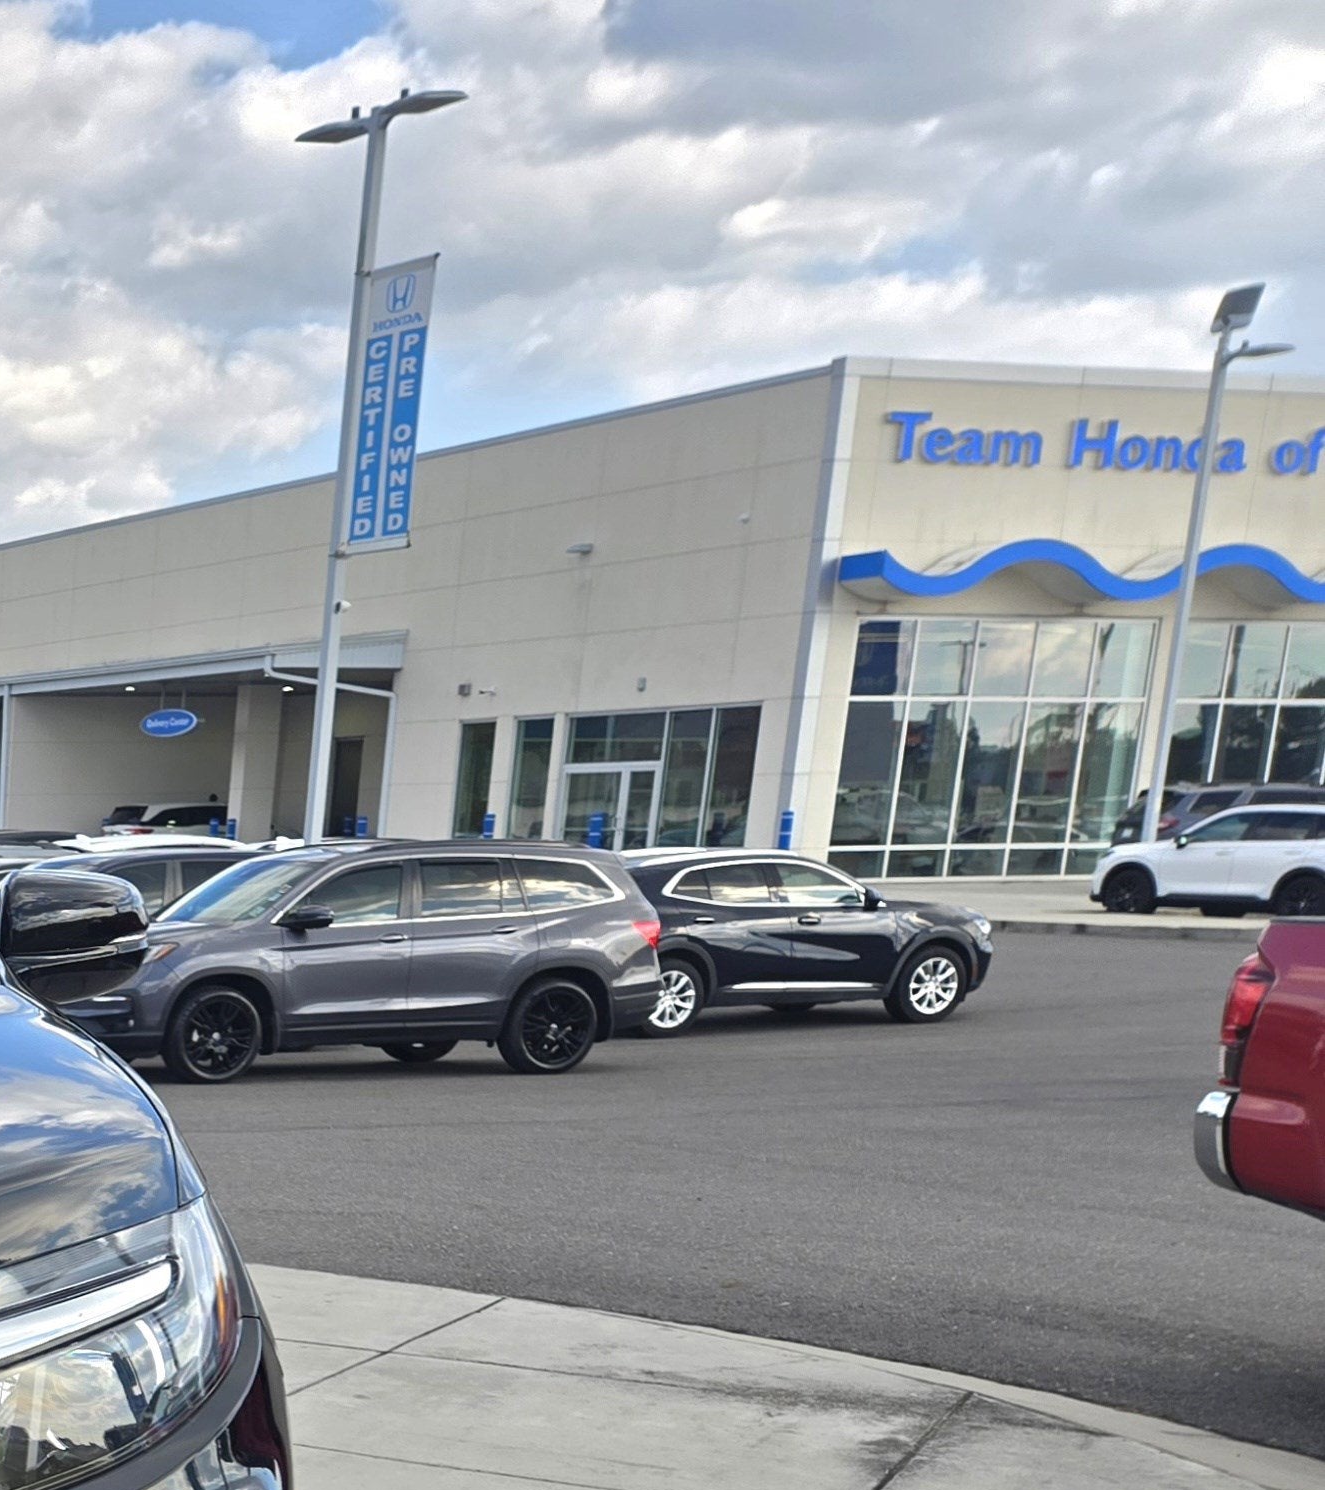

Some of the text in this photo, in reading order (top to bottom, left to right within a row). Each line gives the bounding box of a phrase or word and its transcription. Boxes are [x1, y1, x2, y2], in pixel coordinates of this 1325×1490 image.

[372, 311, 424, 334] HONDA
[353, 341, 388, 536] CERTIFIED
[385, 333, 420, 532] PRE OWNED
[887, 411, 1044, 466] Team
[1272, 426, 1325, 475] of
